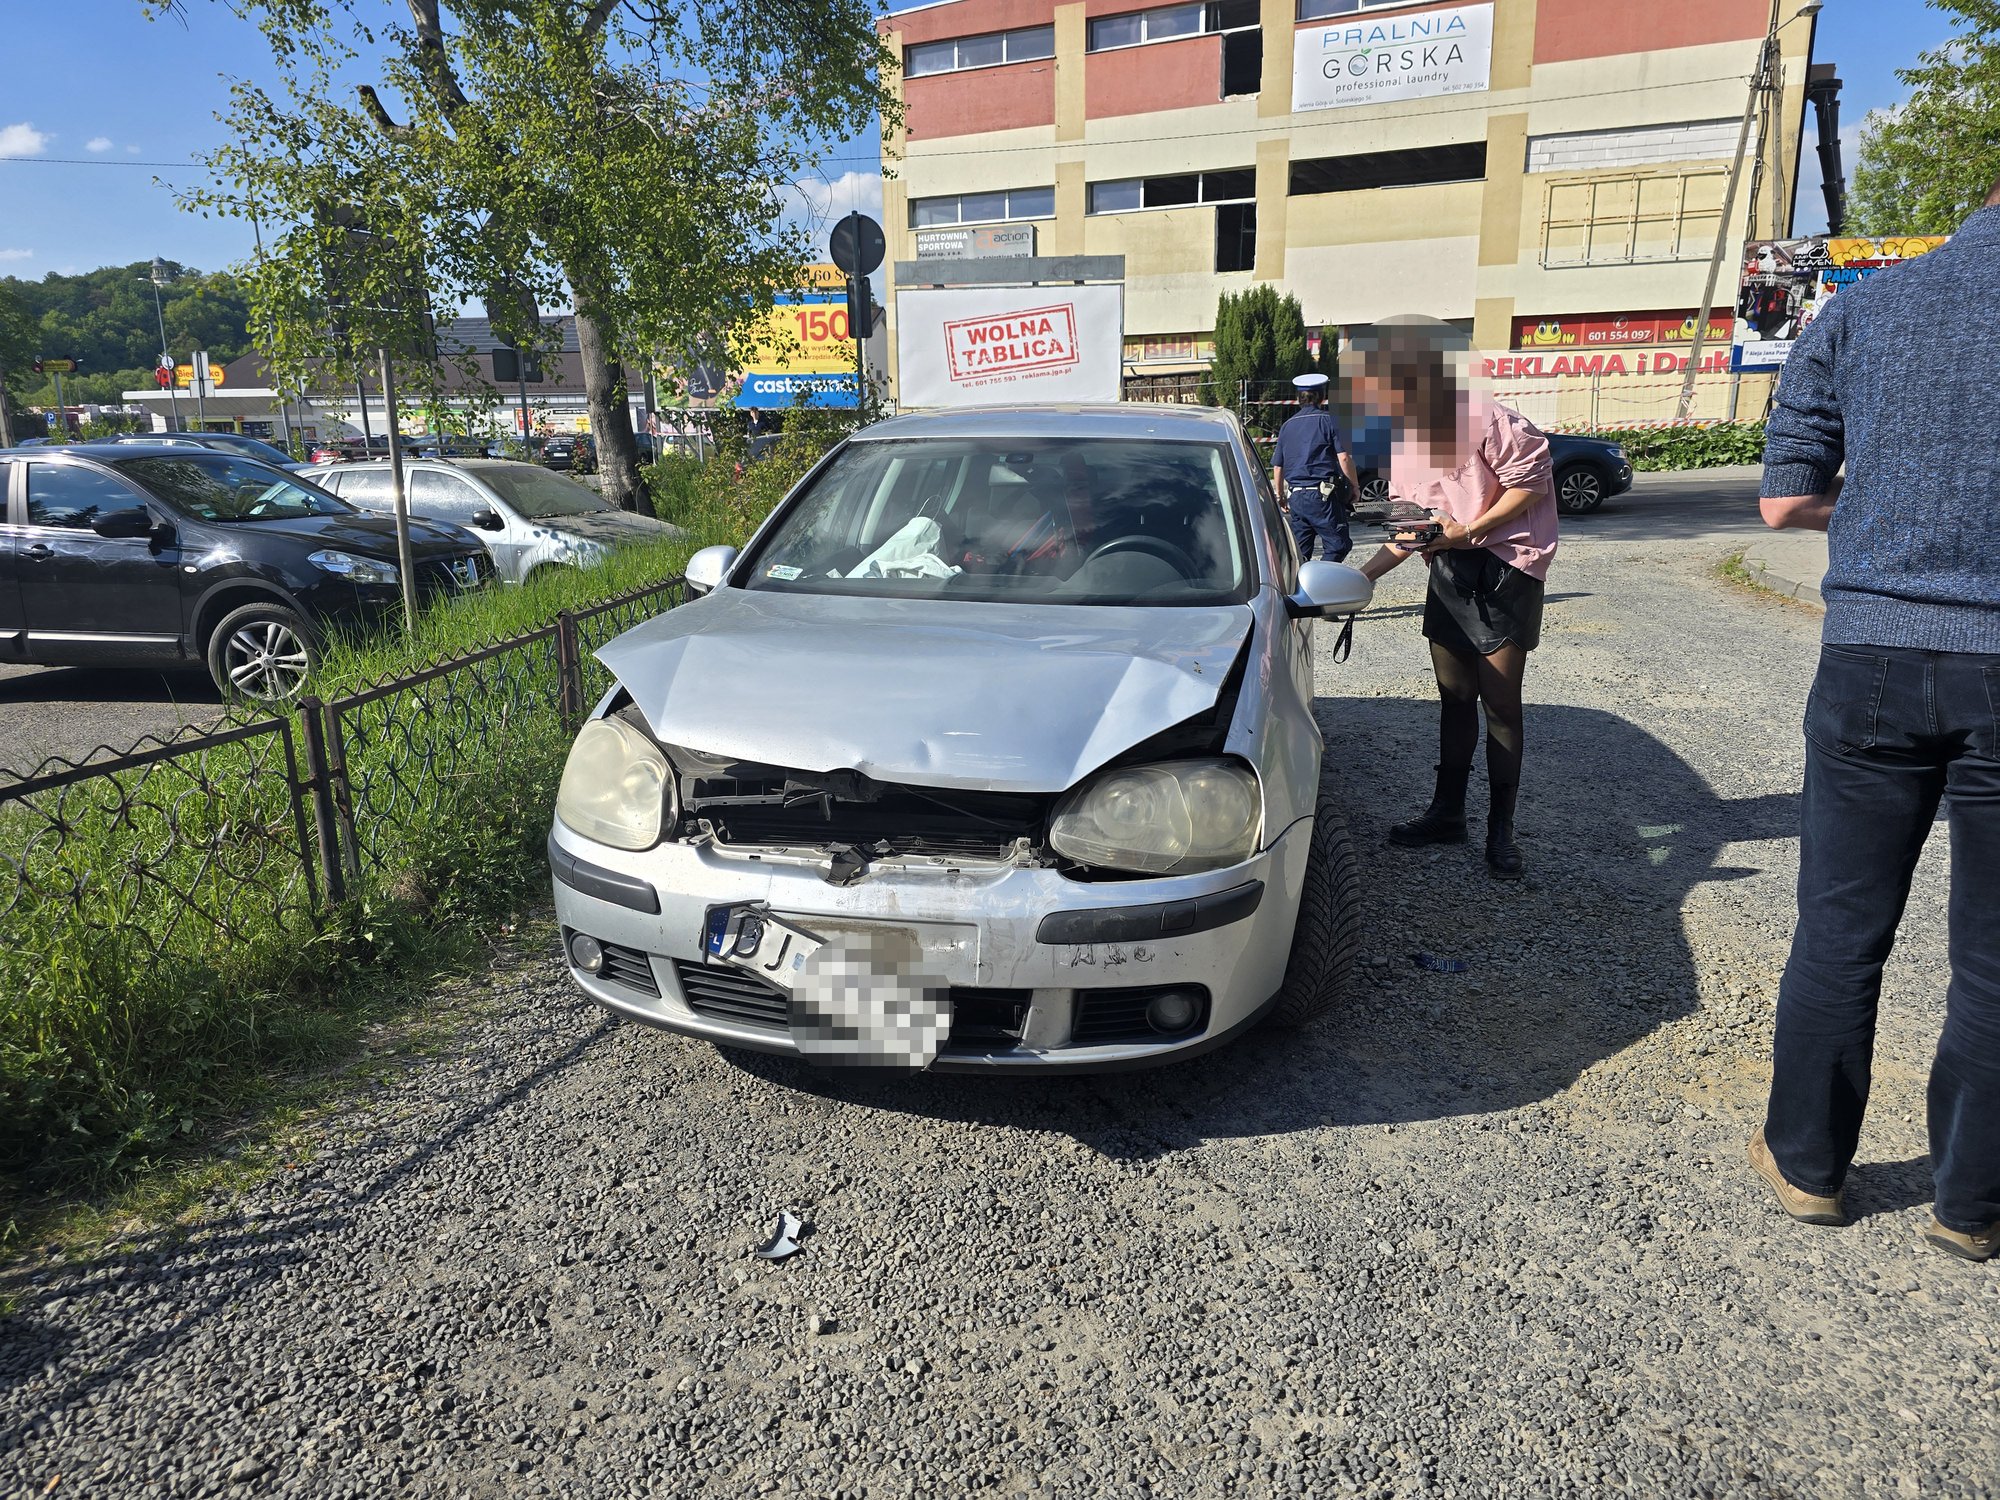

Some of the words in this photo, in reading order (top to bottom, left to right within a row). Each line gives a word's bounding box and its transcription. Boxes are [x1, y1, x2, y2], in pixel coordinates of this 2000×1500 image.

[1323, 15, 1466, 48] PRALNIA
[1335, 76, 1401, 94] professional
[1407, 72, 1449, 84] laundry
[918, 232, 968, 242] HURTOWNIA
[993, 232, 1030, 242] action
[918, 242, 963, 251] SPORTOWA
[1822, 269, 1861, 283] PARK
[794, 310, 849, 342] 150
[967, 318, 1053, 345] WOLNA
[1588, 331, 1607, 342] 601
[1610, 330, 1629, 341] 554
[1631, 329, 1651, 340] 097
[962, 338, 1064, 367] TABLICA
[1144, 337, 1192, 355] BHP
[1637, 353, 1647, 375] i
[1021, 367, 1072, 380] reklama.jga.pl
[47, 413, 54, 423] P
[709, 931, 720, 945] PL
